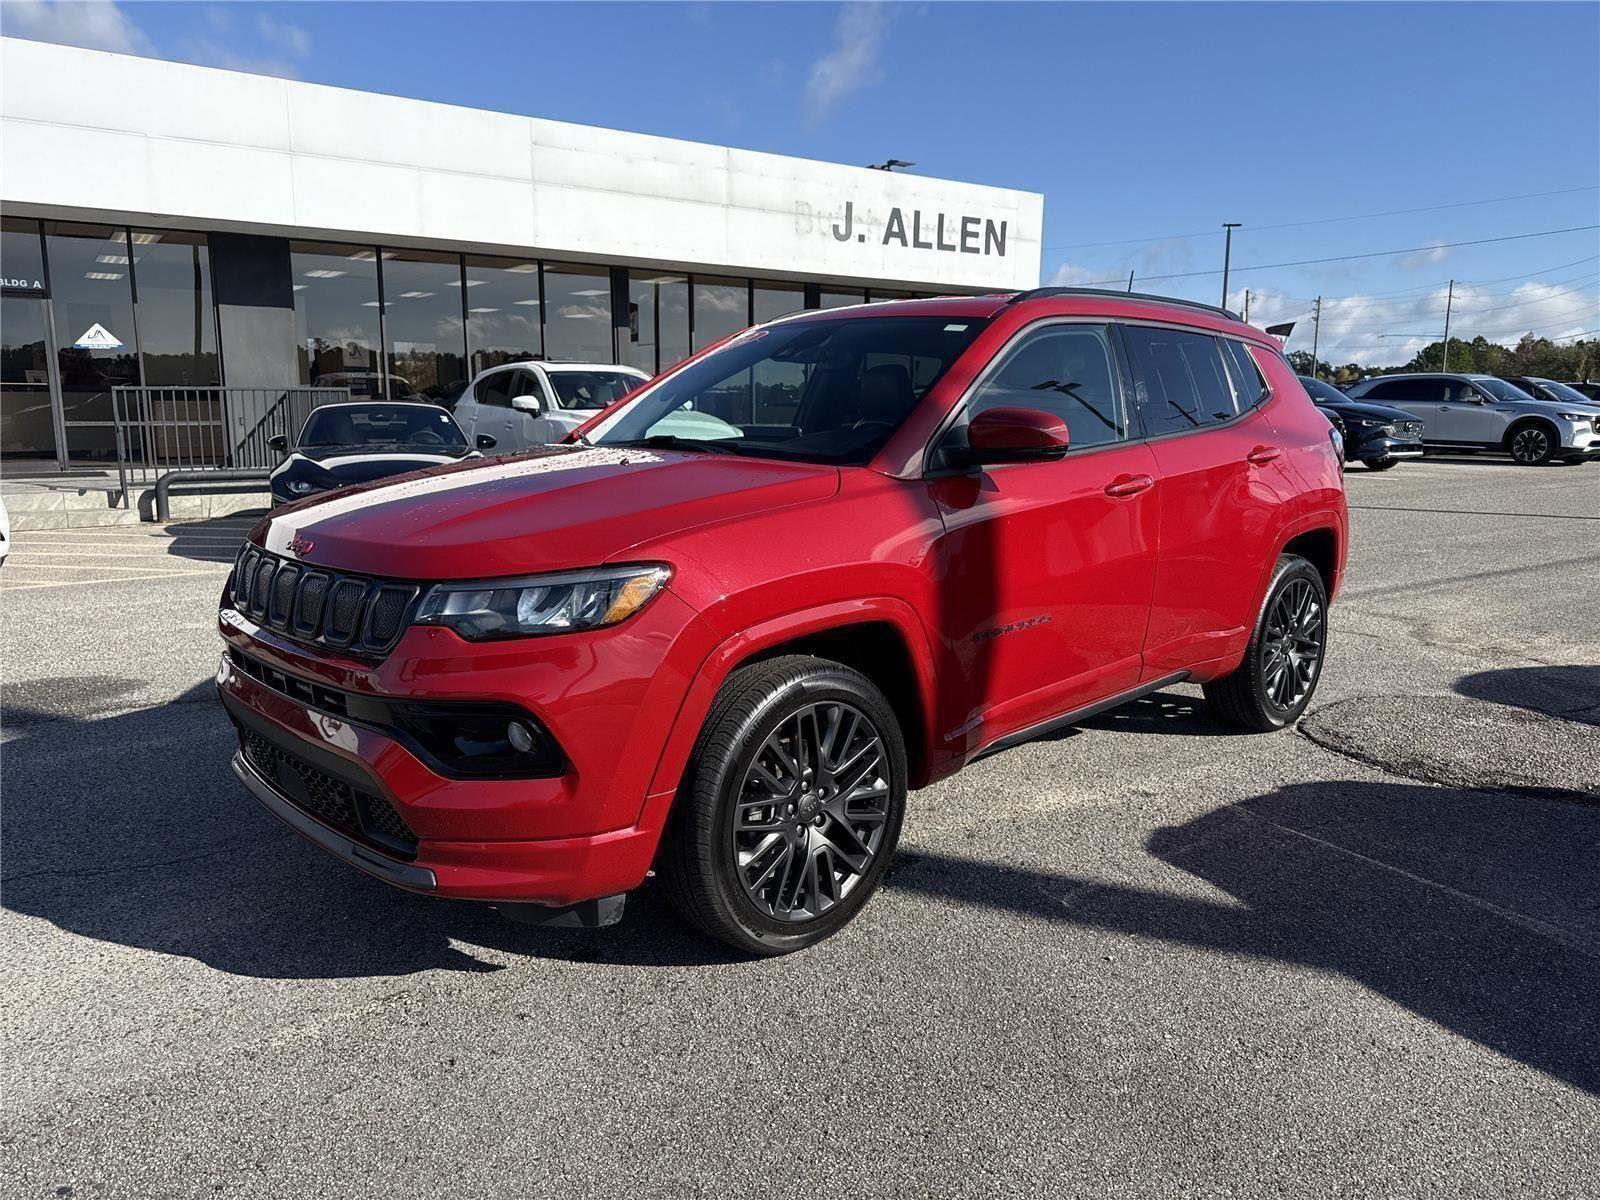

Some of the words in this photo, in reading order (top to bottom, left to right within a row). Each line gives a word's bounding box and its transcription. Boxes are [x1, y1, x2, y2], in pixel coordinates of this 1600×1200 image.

[832, 201, 866, 243] J.
[882, 207, 1008, 257] ALLEN
[0, 278, 28, 288] BLDG
[33, 280, 42, 289] A
